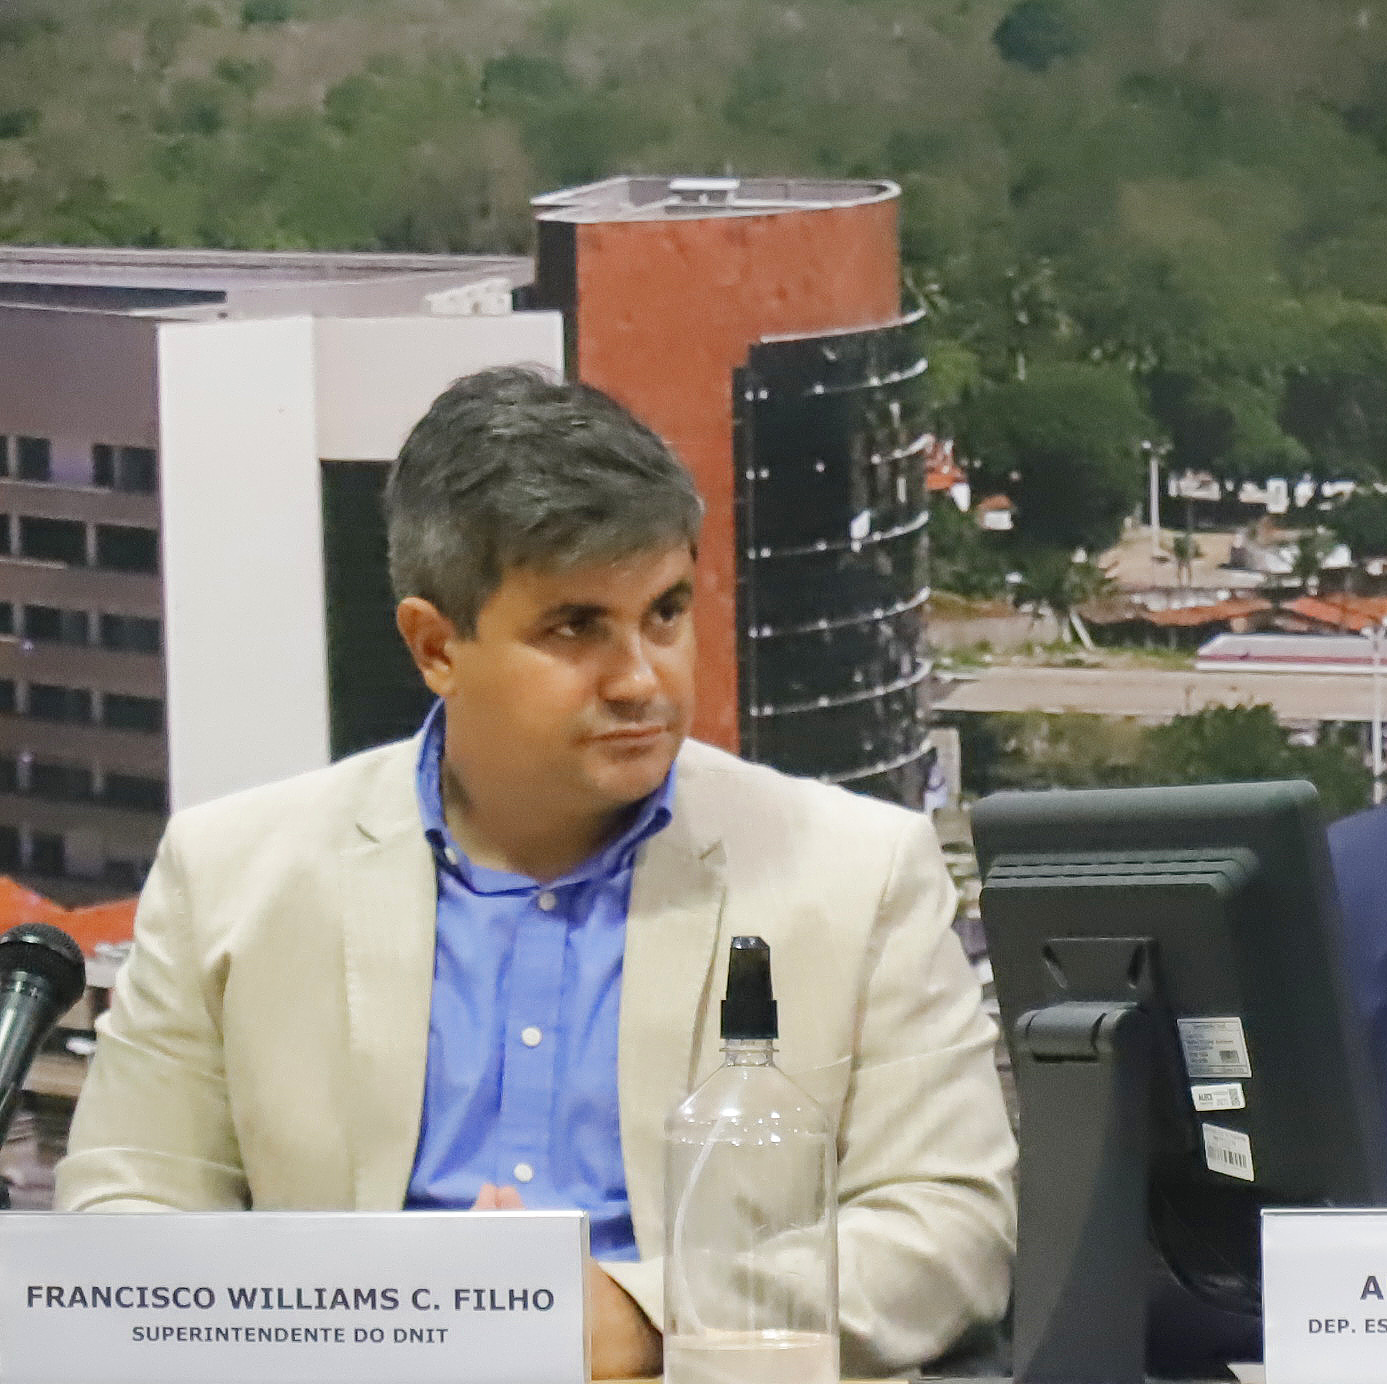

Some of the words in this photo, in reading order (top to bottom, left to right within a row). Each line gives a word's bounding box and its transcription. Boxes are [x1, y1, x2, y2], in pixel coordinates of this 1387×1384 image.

[27, 1285, 216, 1310] FRANCISCO
[227, 1287, 400, 1311] WILLIAMS
[411, 1288, 440, 1311] C.
[454, 1288, 555, 1312] FILHO
[132, 1326, 345, 1343] SUPERINTENDENTE
[354, 1327, 385, 1343] DO
[393, 1327, 449, 1344] DNIT
[1308, 1318, 1356, 1334] DEP.
